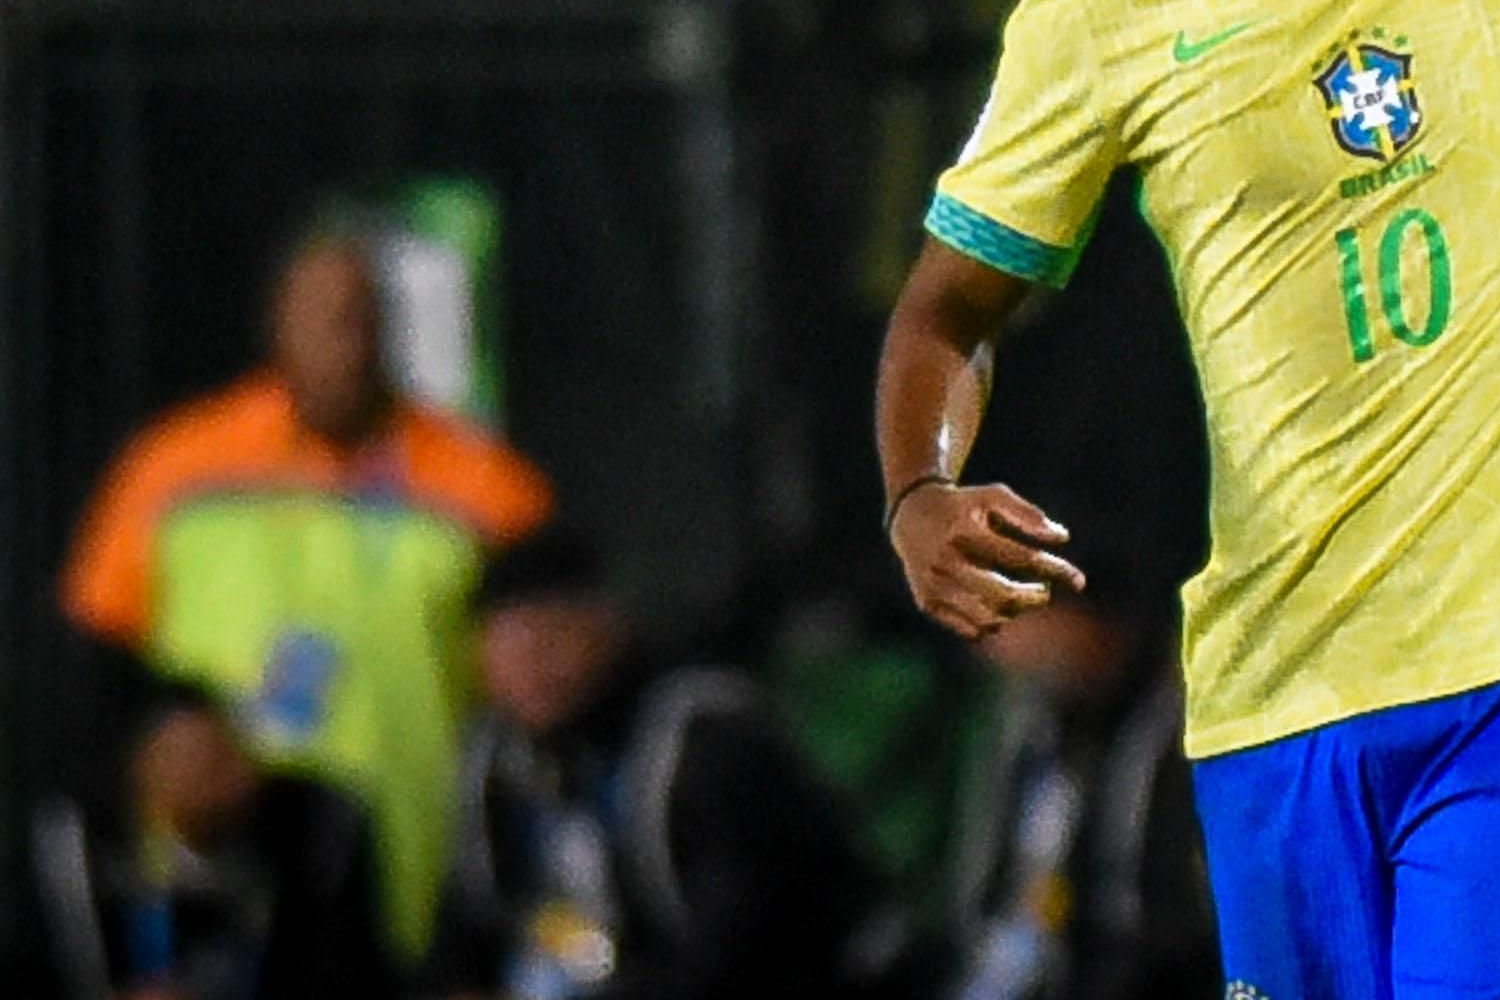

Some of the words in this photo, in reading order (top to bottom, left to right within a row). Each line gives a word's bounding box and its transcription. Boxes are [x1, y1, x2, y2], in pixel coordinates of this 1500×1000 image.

[1353, 90, 1385, 109] CBF
[1339, 154, 1436, 198] BRASIL
[1335, 208, 1451, 363] 10
